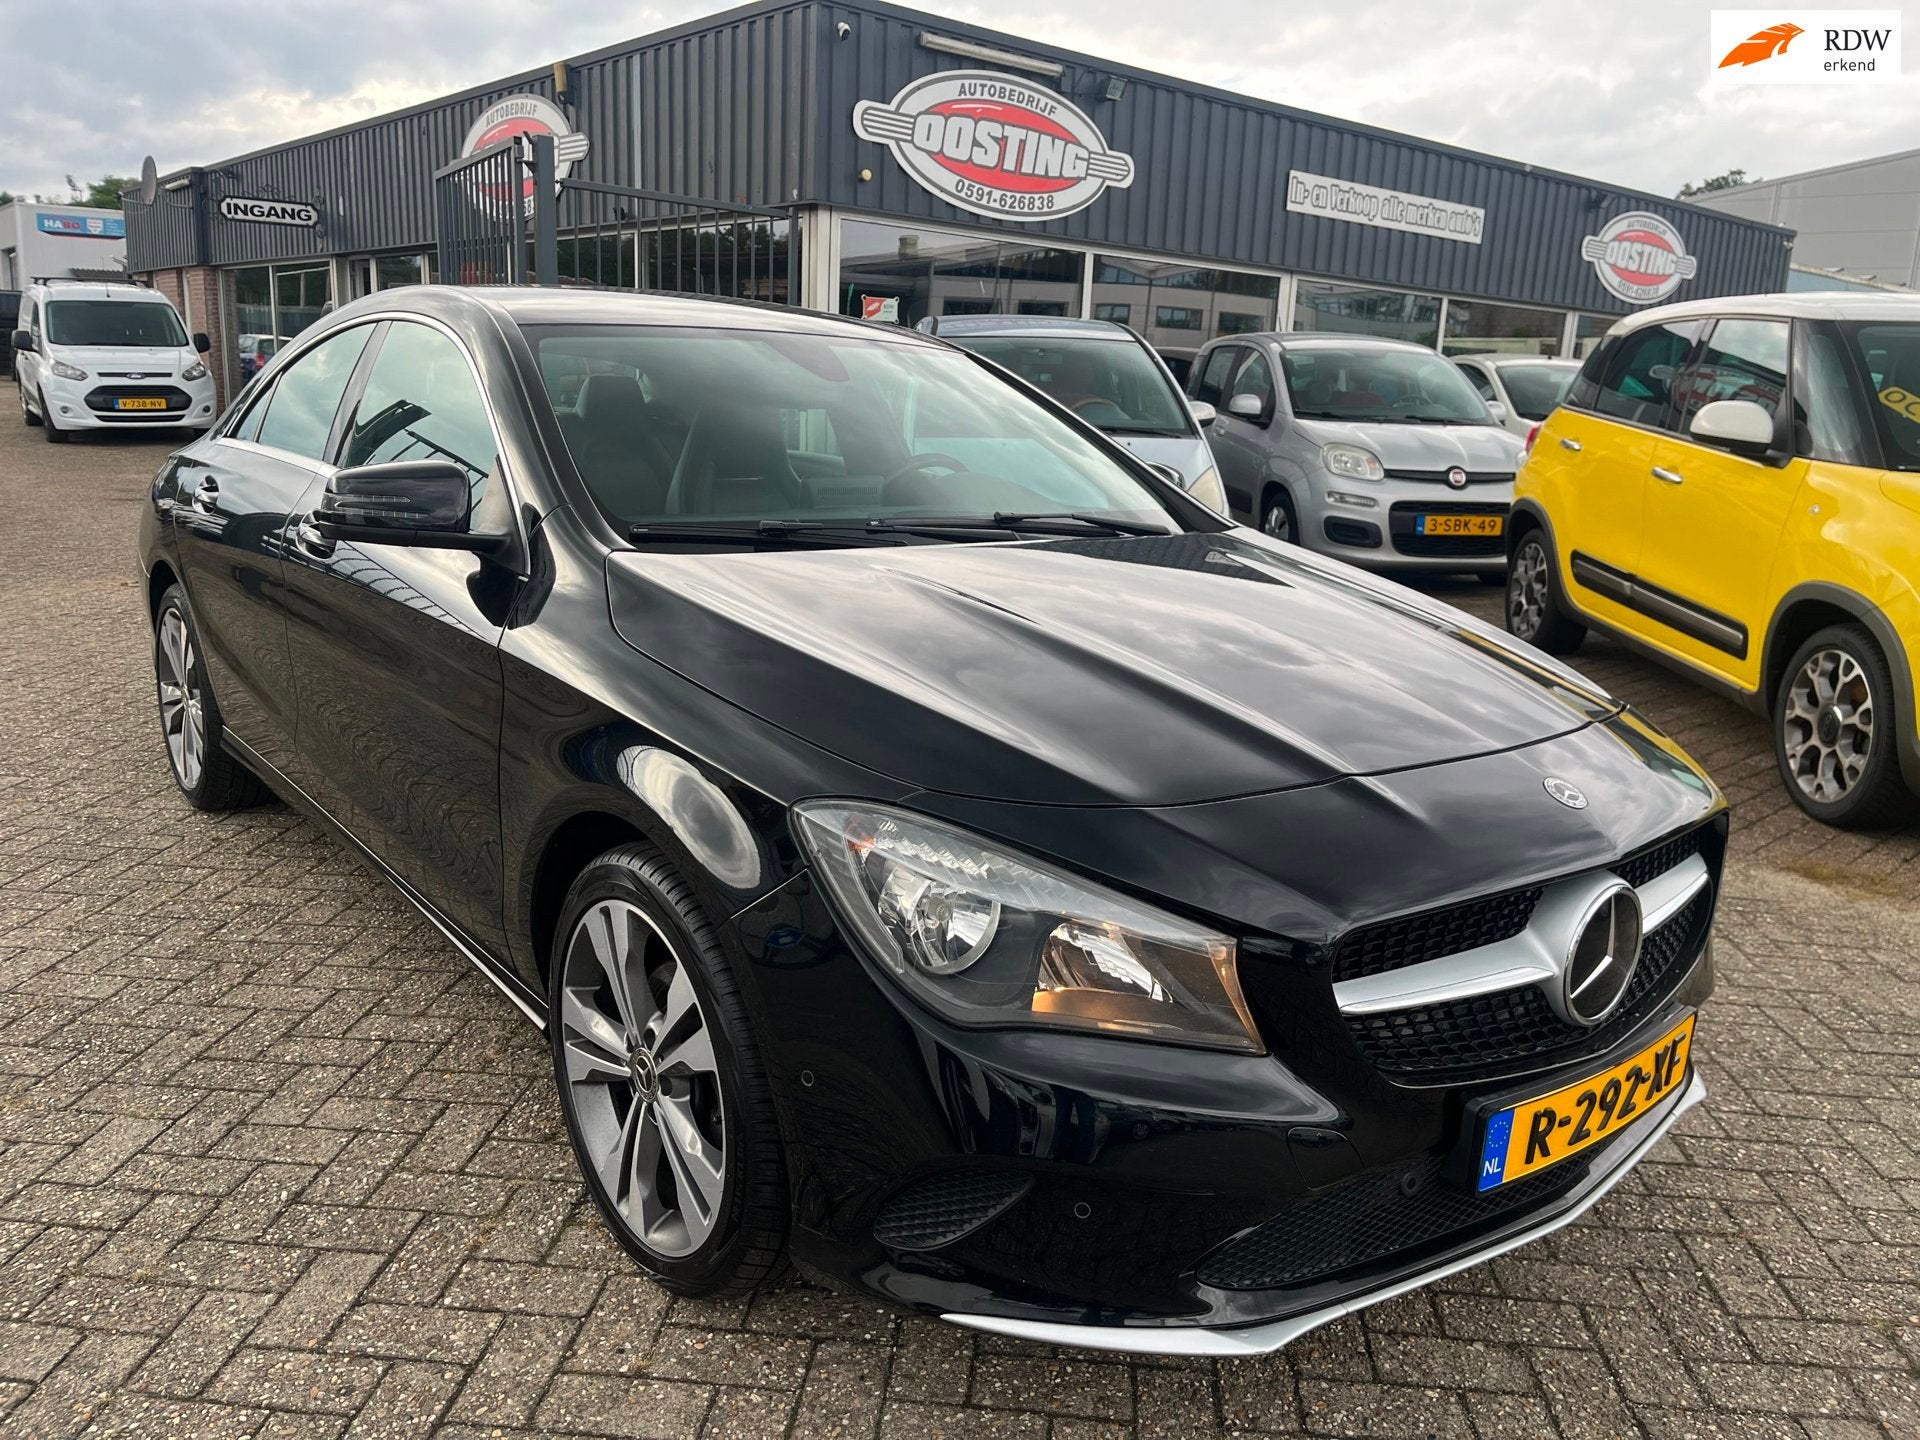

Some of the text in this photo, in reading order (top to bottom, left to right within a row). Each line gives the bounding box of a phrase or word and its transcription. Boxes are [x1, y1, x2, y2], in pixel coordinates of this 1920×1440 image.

[486, 102, 537, 127] AUTOBEDRIJF
[958, 82, 1058, 117] AUTOBEDRIJF
[914, 113, 1090, 180] OOSTING
[955, 178, 1055, 211] 0591-626838
[1290, 176, 1480, 237] In- en Verkoop alle merken auto's
[226, 202, 312, 221] INGANG
[1606, 240, 1677, 275] OOSTING
[121, 400, 163, 408] V-738-NV
[1429, 518, 1497, 532] 3-SBK-49
[1524, 1031, 1687, 1165] R-292-XF
[1483, 1157, 1501, 1177] NL
